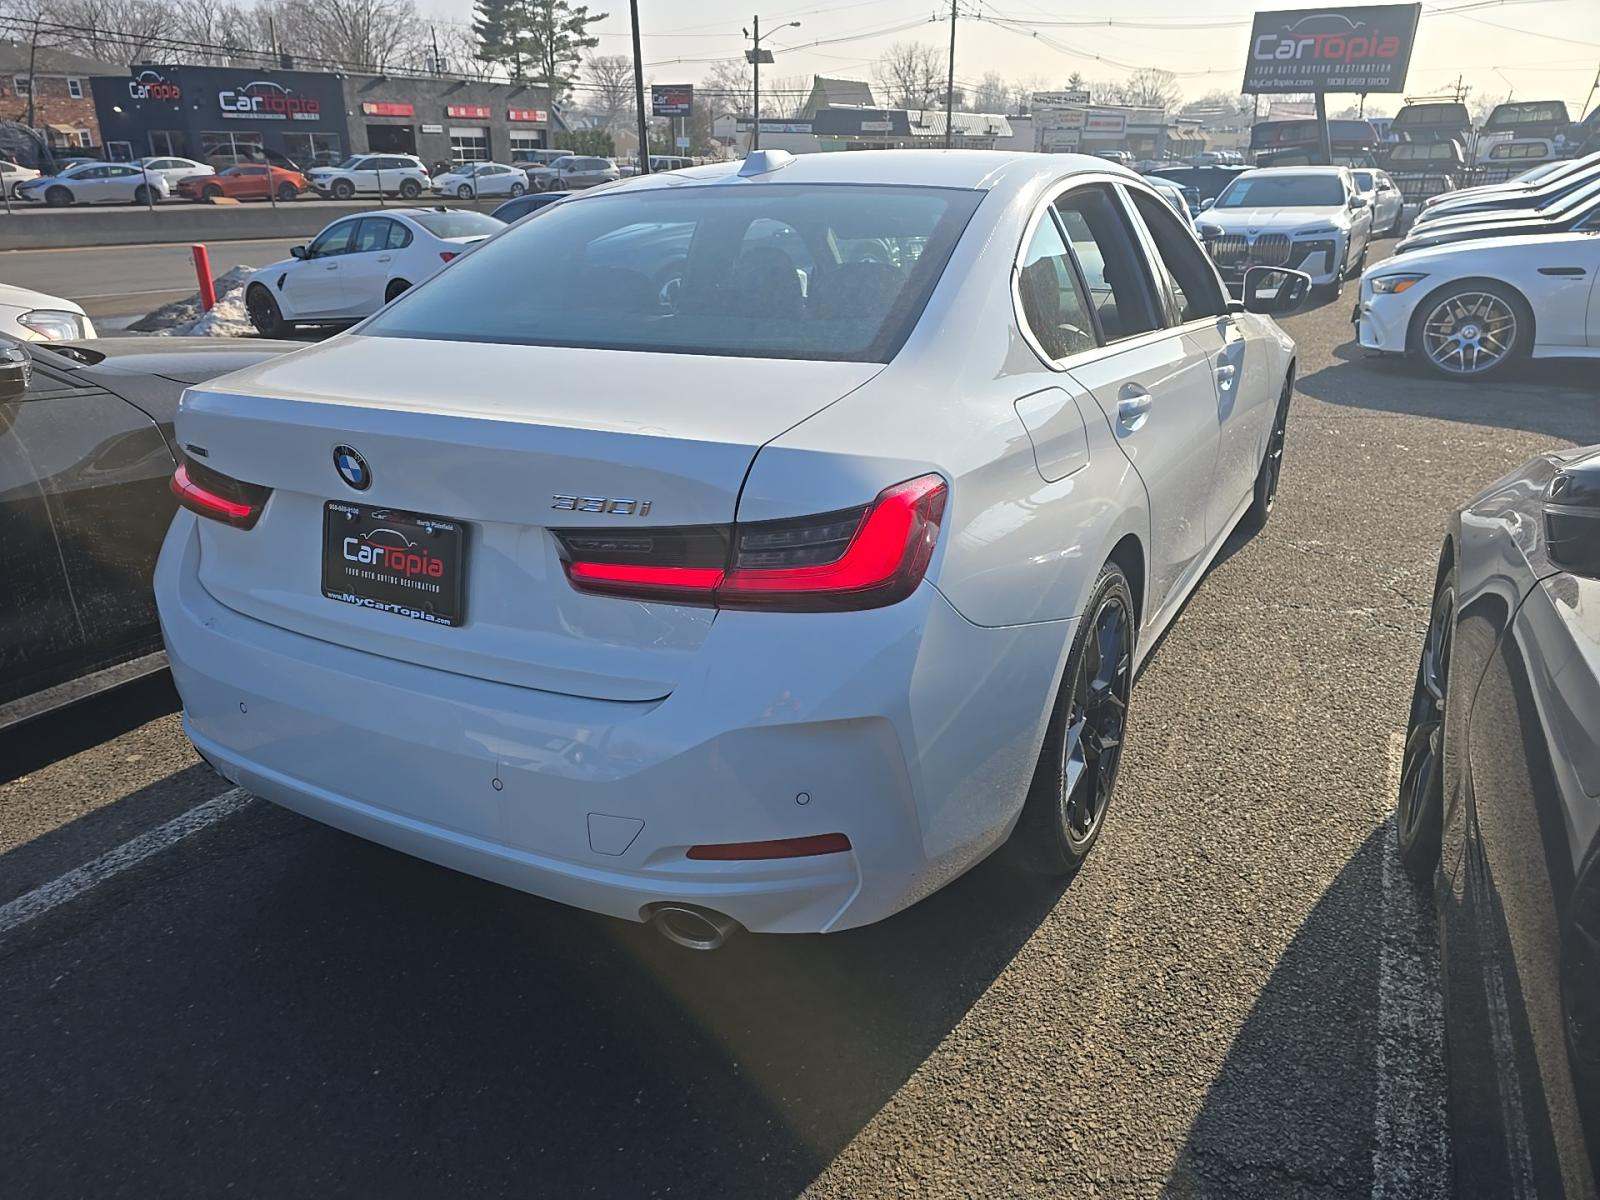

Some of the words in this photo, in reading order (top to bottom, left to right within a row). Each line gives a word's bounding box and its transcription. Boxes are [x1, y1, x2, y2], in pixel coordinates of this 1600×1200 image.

[1254, 30, 1400, 65] CarTopia
[1277, 66, 1298, 75] AUTO
[1334, 64, 1392, 73] DESTINATION
[128, 81, 181, 101] CarTopia
[218, 91, 321, 120] CarTopia
[551, 494, 652, 517] 330i
[343, 537, 443, 577] CarTopia
[361, 570, 375, 580] AUTO
[400, 578, 440, 593] DESTINATION
[327, 592, 451, 626] www.MyCarTopia.com
